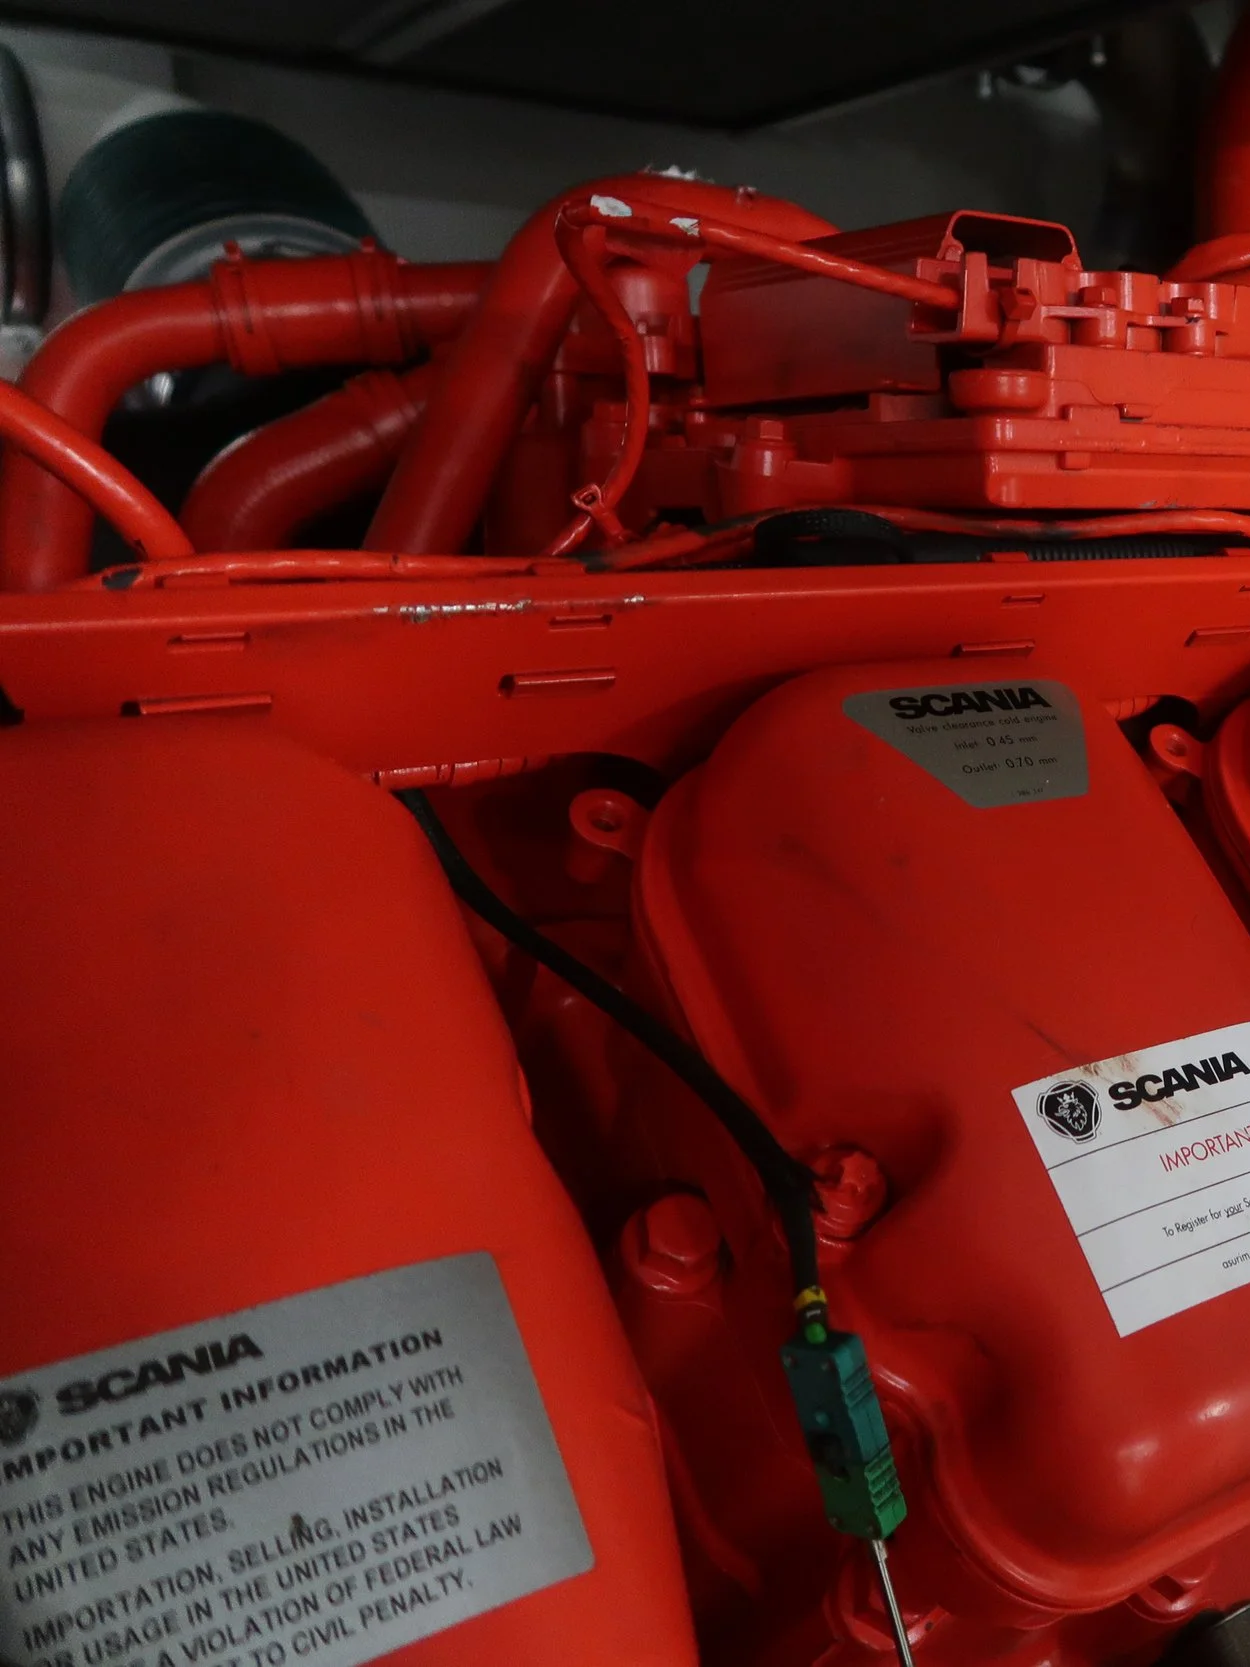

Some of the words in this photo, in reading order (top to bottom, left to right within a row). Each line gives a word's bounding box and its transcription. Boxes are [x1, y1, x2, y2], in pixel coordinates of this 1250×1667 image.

[889, 688, 1052, 719] SCANIA
[906, 724, 938, 735] Valve
[943, 718, 995, 732] clearance
[999, 715, 1021, 725] cold
[1024, 714, 1057, 725] engine
[1005, 756, 1034, 769] 0.70
[1039, 757, 1058, 765] mm
[1162, 1226, 1175, 1238] To
[1174, 1213, 1209, 1234] Register
[1208, 1208, 1222, 1221] for
[1223, 1202, 1245, 1219] your
[0, 1397, 207, 1485] MPORTANT
[220, 1328, 443, 1413] INFORMATION
[56, 1333, 263, 1417] SCANIA
[2, 1493, 65, 1537] THIS
[69, 1457, 172, 1514] ENGINE
[176, 1432, 249, 1480] DOES
[253, 1414, 302, 1450] NOT
[309, 1383, 404, 1432] COMPLY
[408, 1363, 464, 1398] WITH
[9, 1527, 65, 1571] ANY
[72, 1483, 201, 1547] EMISSION
[206, 1421, 381, 1499] REGULATIONS
[382, 1412, 407, 1439] IN
[411, 1396, 455, 1427] THE
[14, 1545, 119, 1603] UNITED
[123, 1507, 235, 1566] STATES.
[23, 1560, 224, 1652] IMPORTATION,
[228, 1516, 341, 1576] SELLING,
[343, 1456, 504, 1532] INSTALLATION
[82, 1608, 181, 1666] USAGE
[185, 1597, 213, 1628] IN
[219, 1572, 272, 1612] THE
[275, 1539, 367, 1591] UNITED
[371, 1503, 460, 1555] STATES
[179, 1589, 320, 1664] VIOLATION
[325, 1573, 358, 1608] OF
[364, 1534, 472, 1592] FEDERAL
[474, 1512, 522, 1549] LAW
[249, 1640, 288, 1667] TO
[291, 1615, 356, 1657] CIVIL
